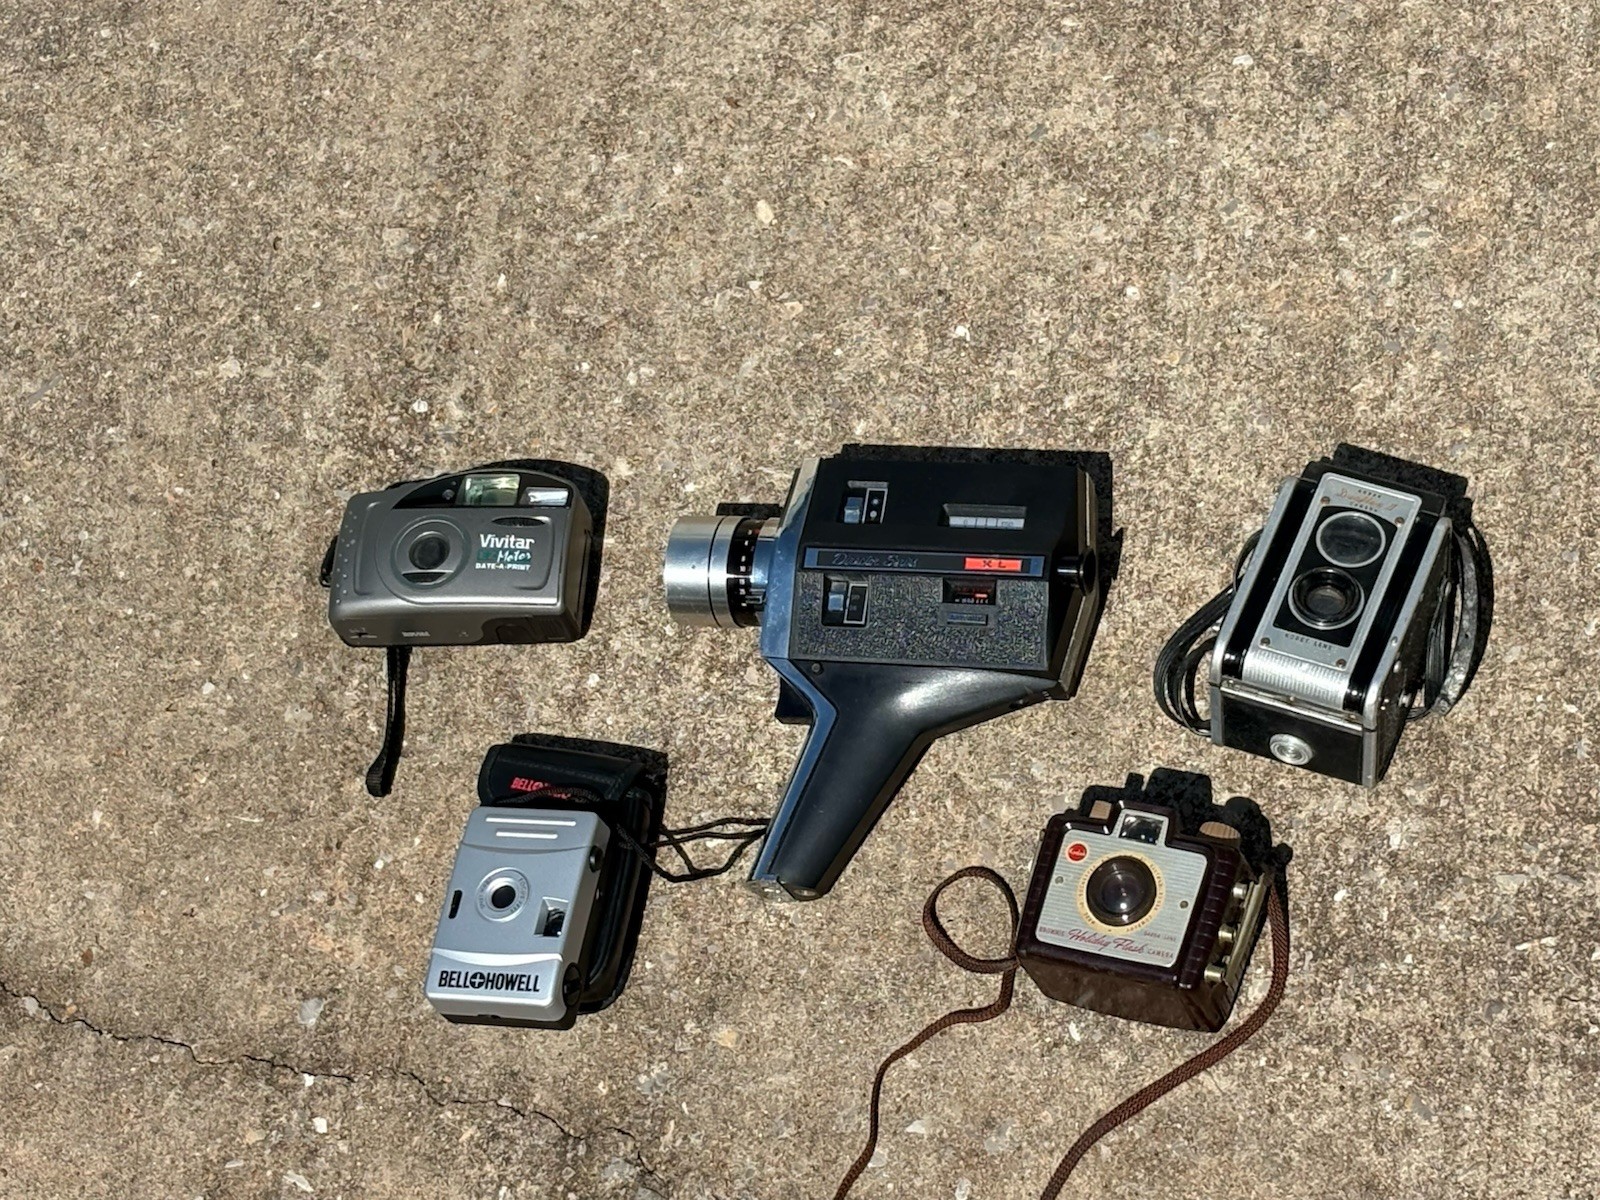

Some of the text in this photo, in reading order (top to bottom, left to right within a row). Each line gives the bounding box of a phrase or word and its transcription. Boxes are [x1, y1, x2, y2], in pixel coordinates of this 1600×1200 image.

[480, 533, 535, 550] Vivitar
[1068, 928, 1110, 951] Holiday
[1112, 937, 1149, 954] Flash
